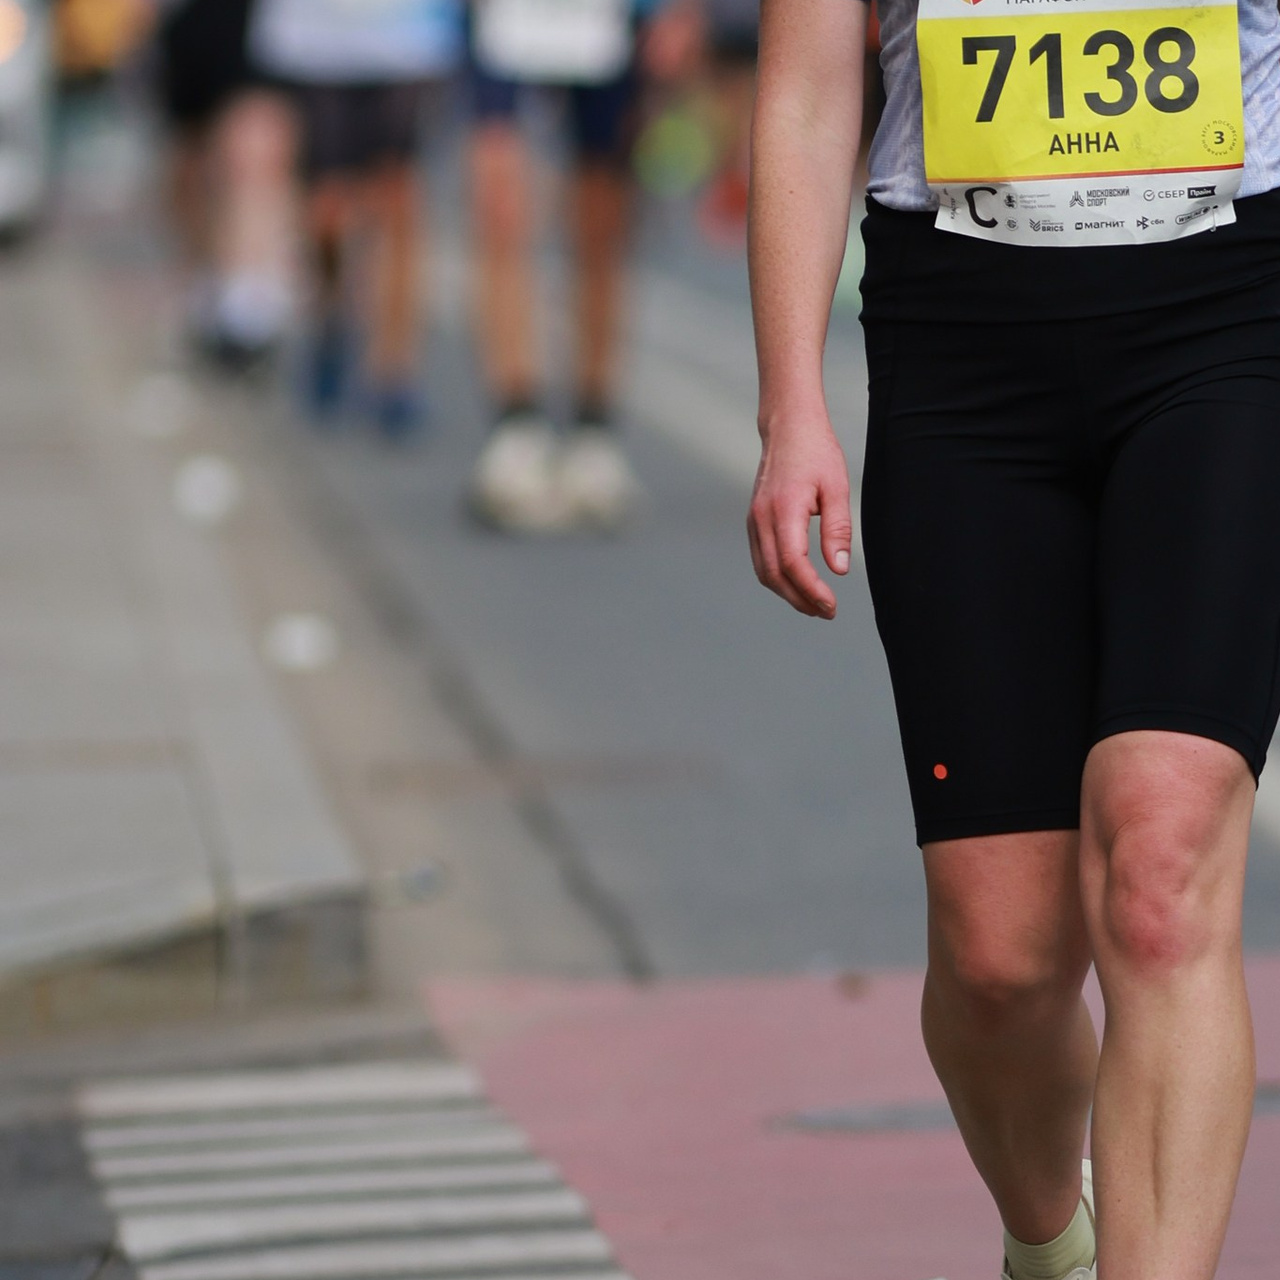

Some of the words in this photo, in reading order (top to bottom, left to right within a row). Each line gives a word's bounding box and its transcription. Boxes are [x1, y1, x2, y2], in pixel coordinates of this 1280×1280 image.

[961, 26, 1200, 123] 7138
[1048, 131, 1120, 155] АННА
[1214, 131, 1225, 144] 3
[1086, 186, 1130, 198] МОСКОВСКИЙ
[1158, 190, 1185, 199] СБЕР
[964, 186, 999, 228] C
[1086, 198, 1107, 207] СПОРТ
